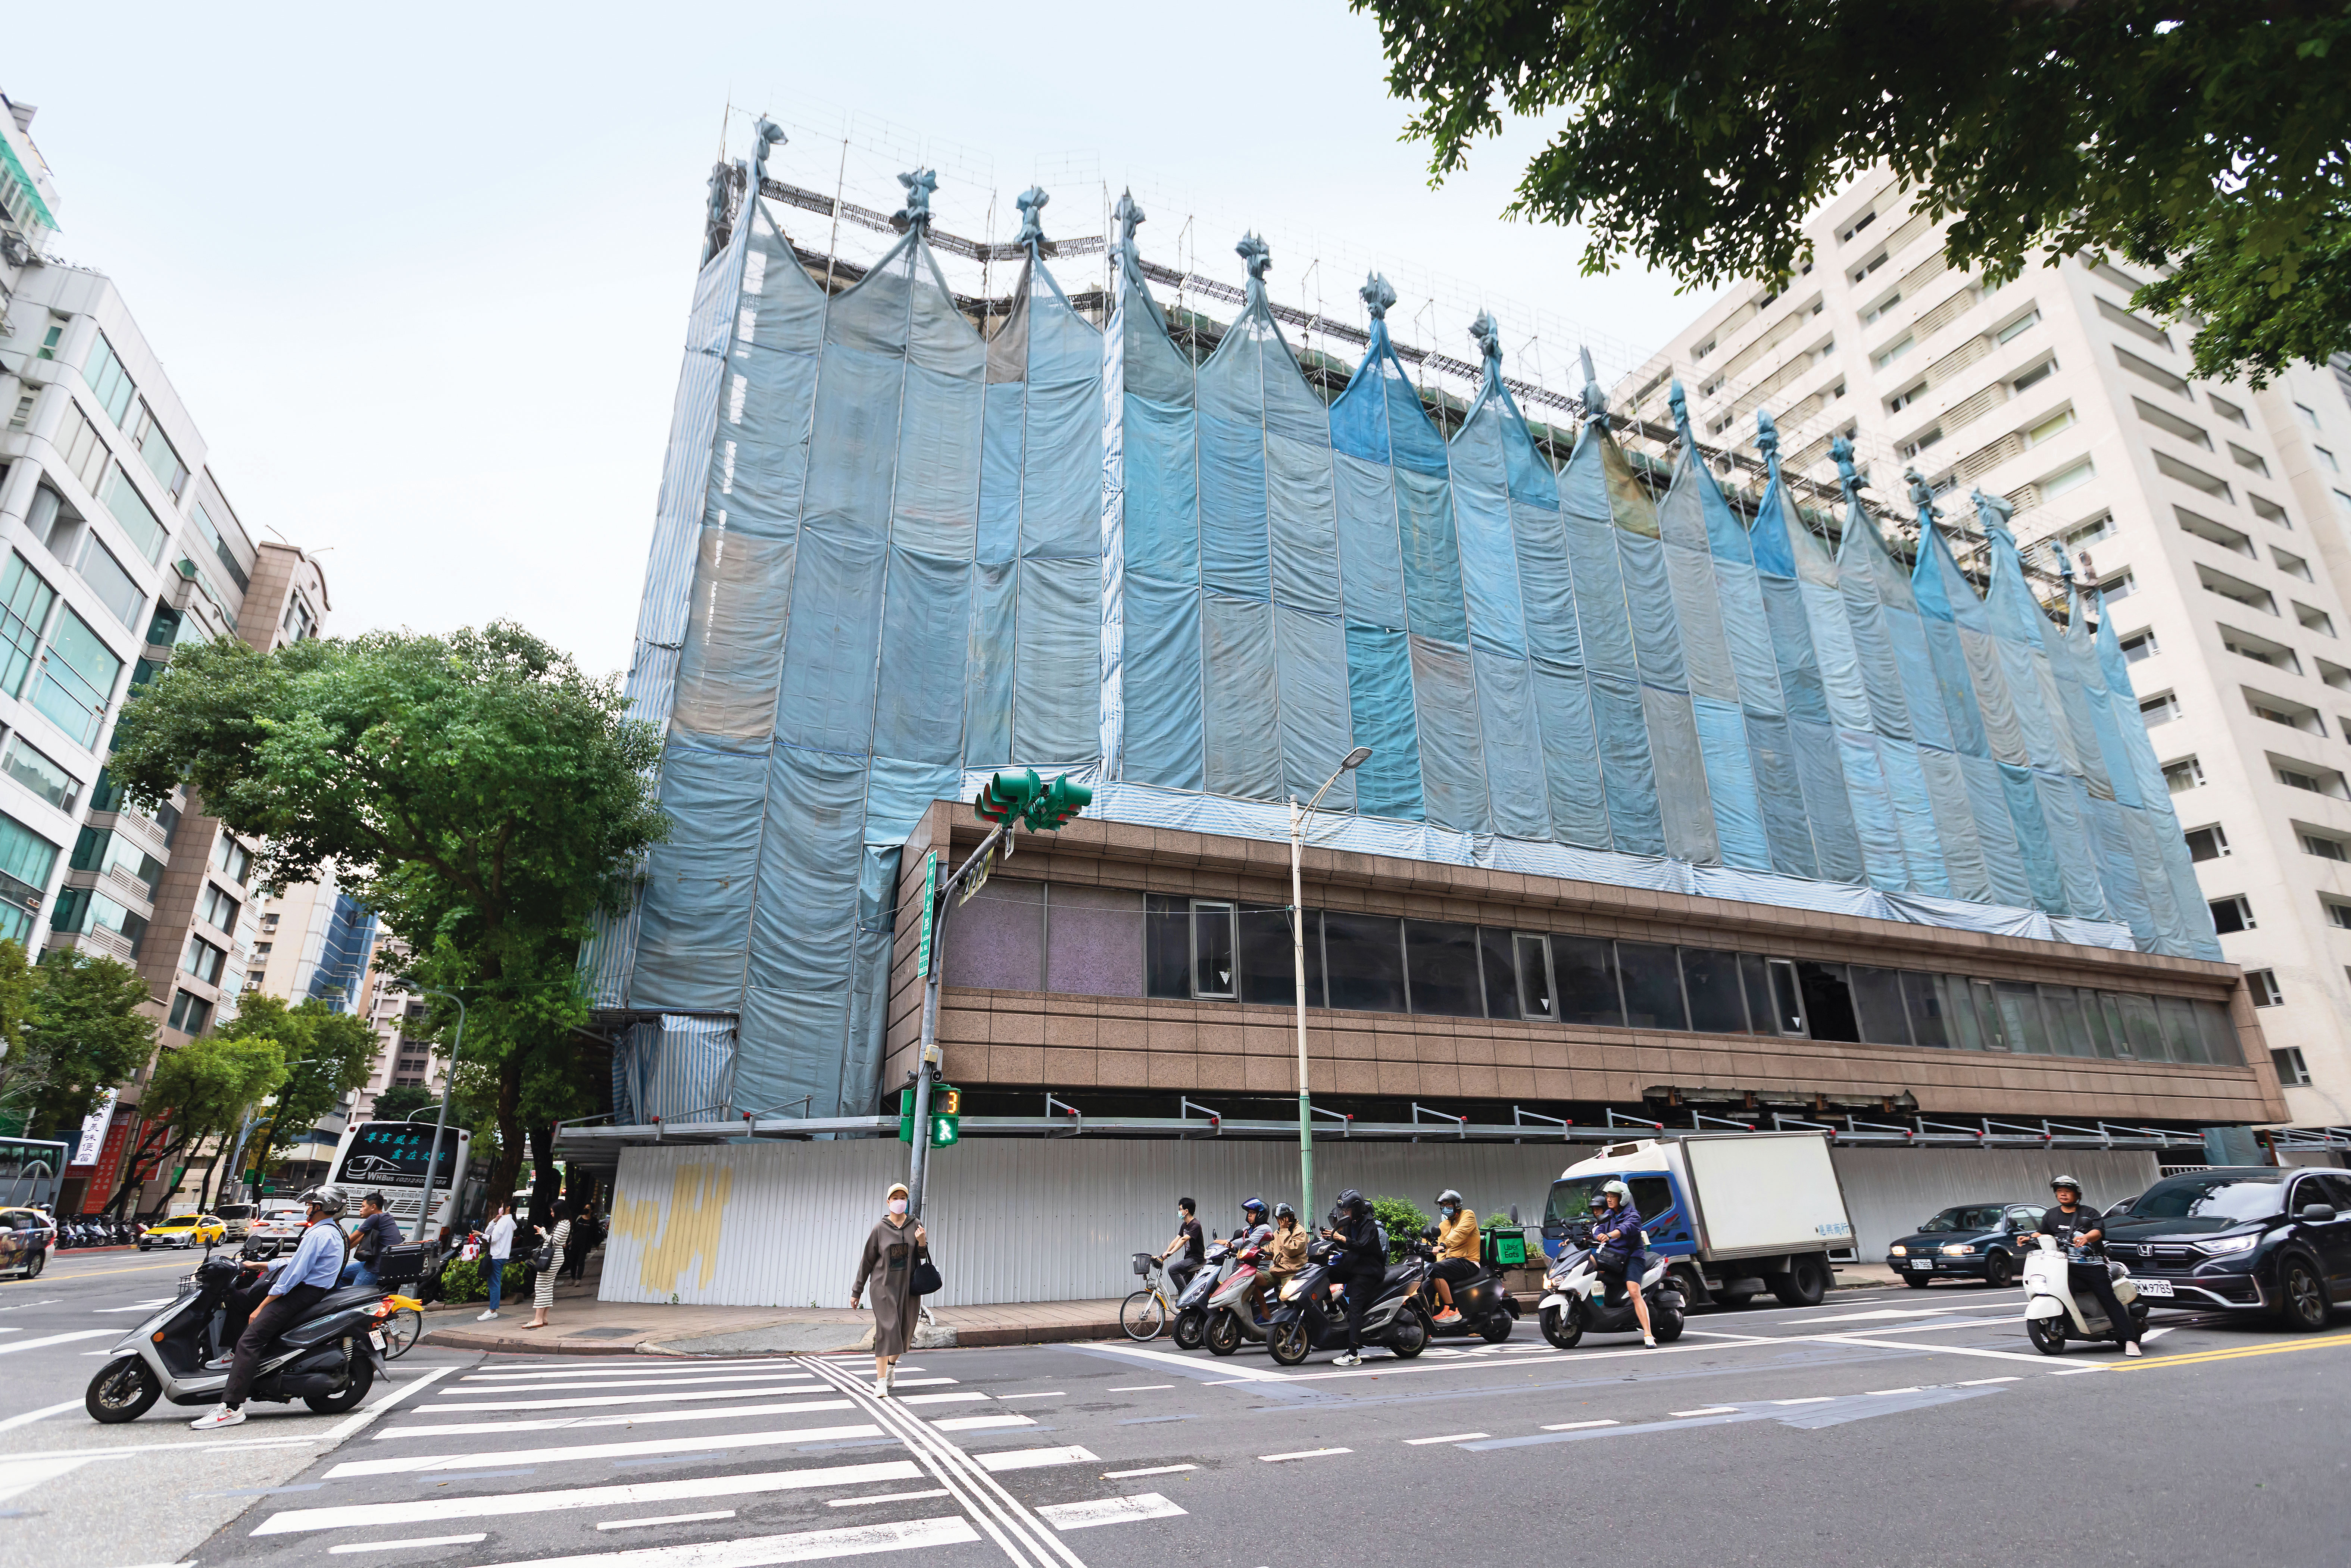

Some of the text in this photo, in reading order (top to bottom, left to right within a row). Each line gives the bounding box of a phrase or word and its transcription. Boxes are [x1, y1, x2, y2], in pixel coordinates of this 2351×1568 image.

[923, 865, 933, 932] 林森北路
[921, 934, 930, 943] LinSen
[948, 1092, 957, 1113] 3
[364, 1132, 420, 1146] 尊享風華
[367, 1171, 394, 1181] WHBus
